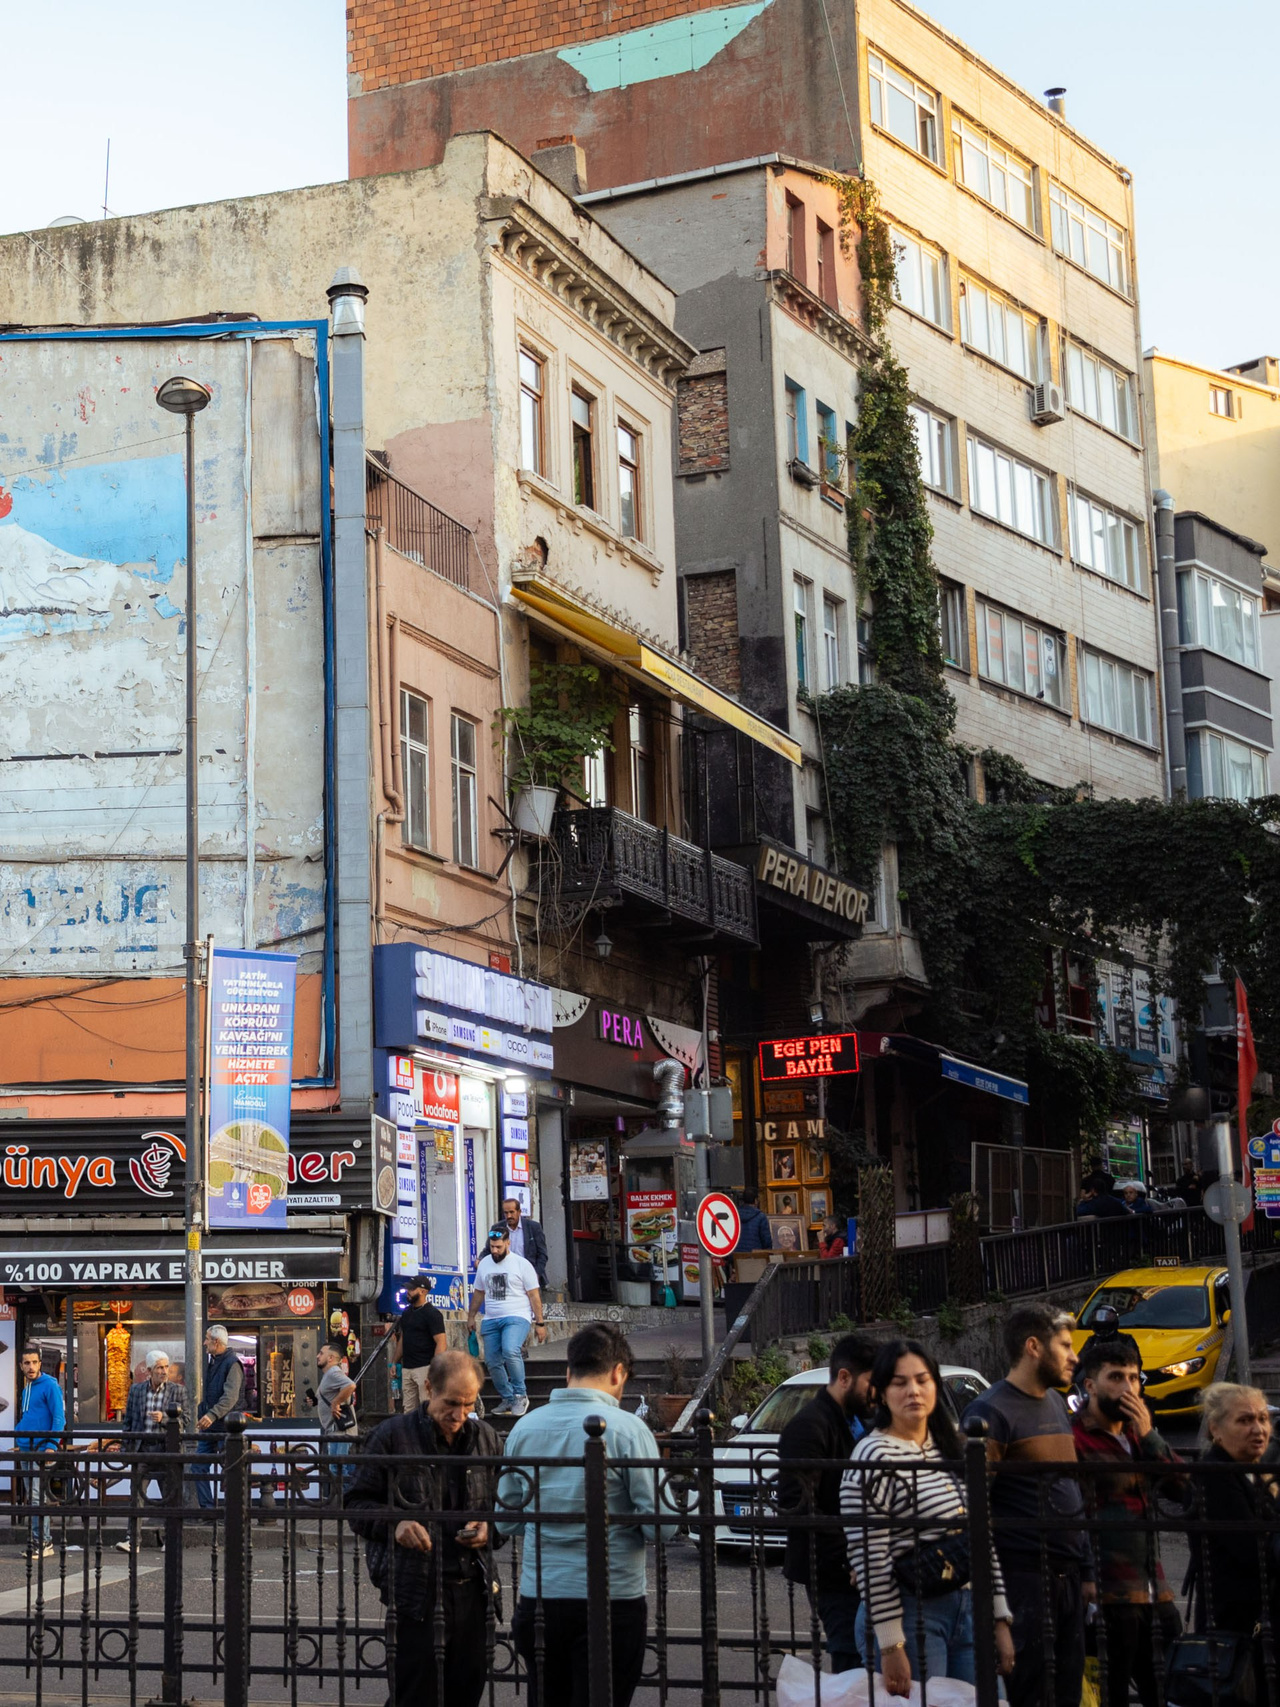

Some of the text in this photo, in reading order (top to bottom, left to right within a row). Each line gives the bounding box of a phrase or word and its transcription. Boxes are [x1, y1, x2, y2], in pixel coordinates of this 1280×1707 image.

[761, 847, 869, 925] PERA DEKOR
[239, 971, 267, 980] FATİH
[222, 979, 283, 989] YATIRIMLARLA
[226, 987, 280, 998] GÜÇLENİYOR
[221, 1003, 281, 1014] UNKAPANI
[224, 1015, 278, 1028] KÖPRÜLÜ
[431, 1023, 447, 1036] iPhone
[453, 1025, 476, 1042] SAMSUNG
[602, 1010, 644, 1049] PERA
[214, 1043, 289, 1056] YENİLEYEREK
[773, 1037, 842, 1059] EGE PEN
[227, 1058, 276, 1070] HİZMETE
[786, 1054, 834, 1076] BAYİİ
[234, 1073, 269, 1086] AÇTIK
[397, 1101, 414, 1117] POCO
[424, 1103, 459, 1120] vodafone
[398, 1177, 416, 1193] SAMSUNG
[630, 1193, 673, 1202] BALIK EKMEK
[399, 1216, 417, 1228] oppo
[5, 1263, 63, 1281] %100
[69, 1263, 161, 1280] YAPRAK
[205, 1258, 285, 1279] DÖNER
[1156, 1259, 1177, 1267] TAXI
